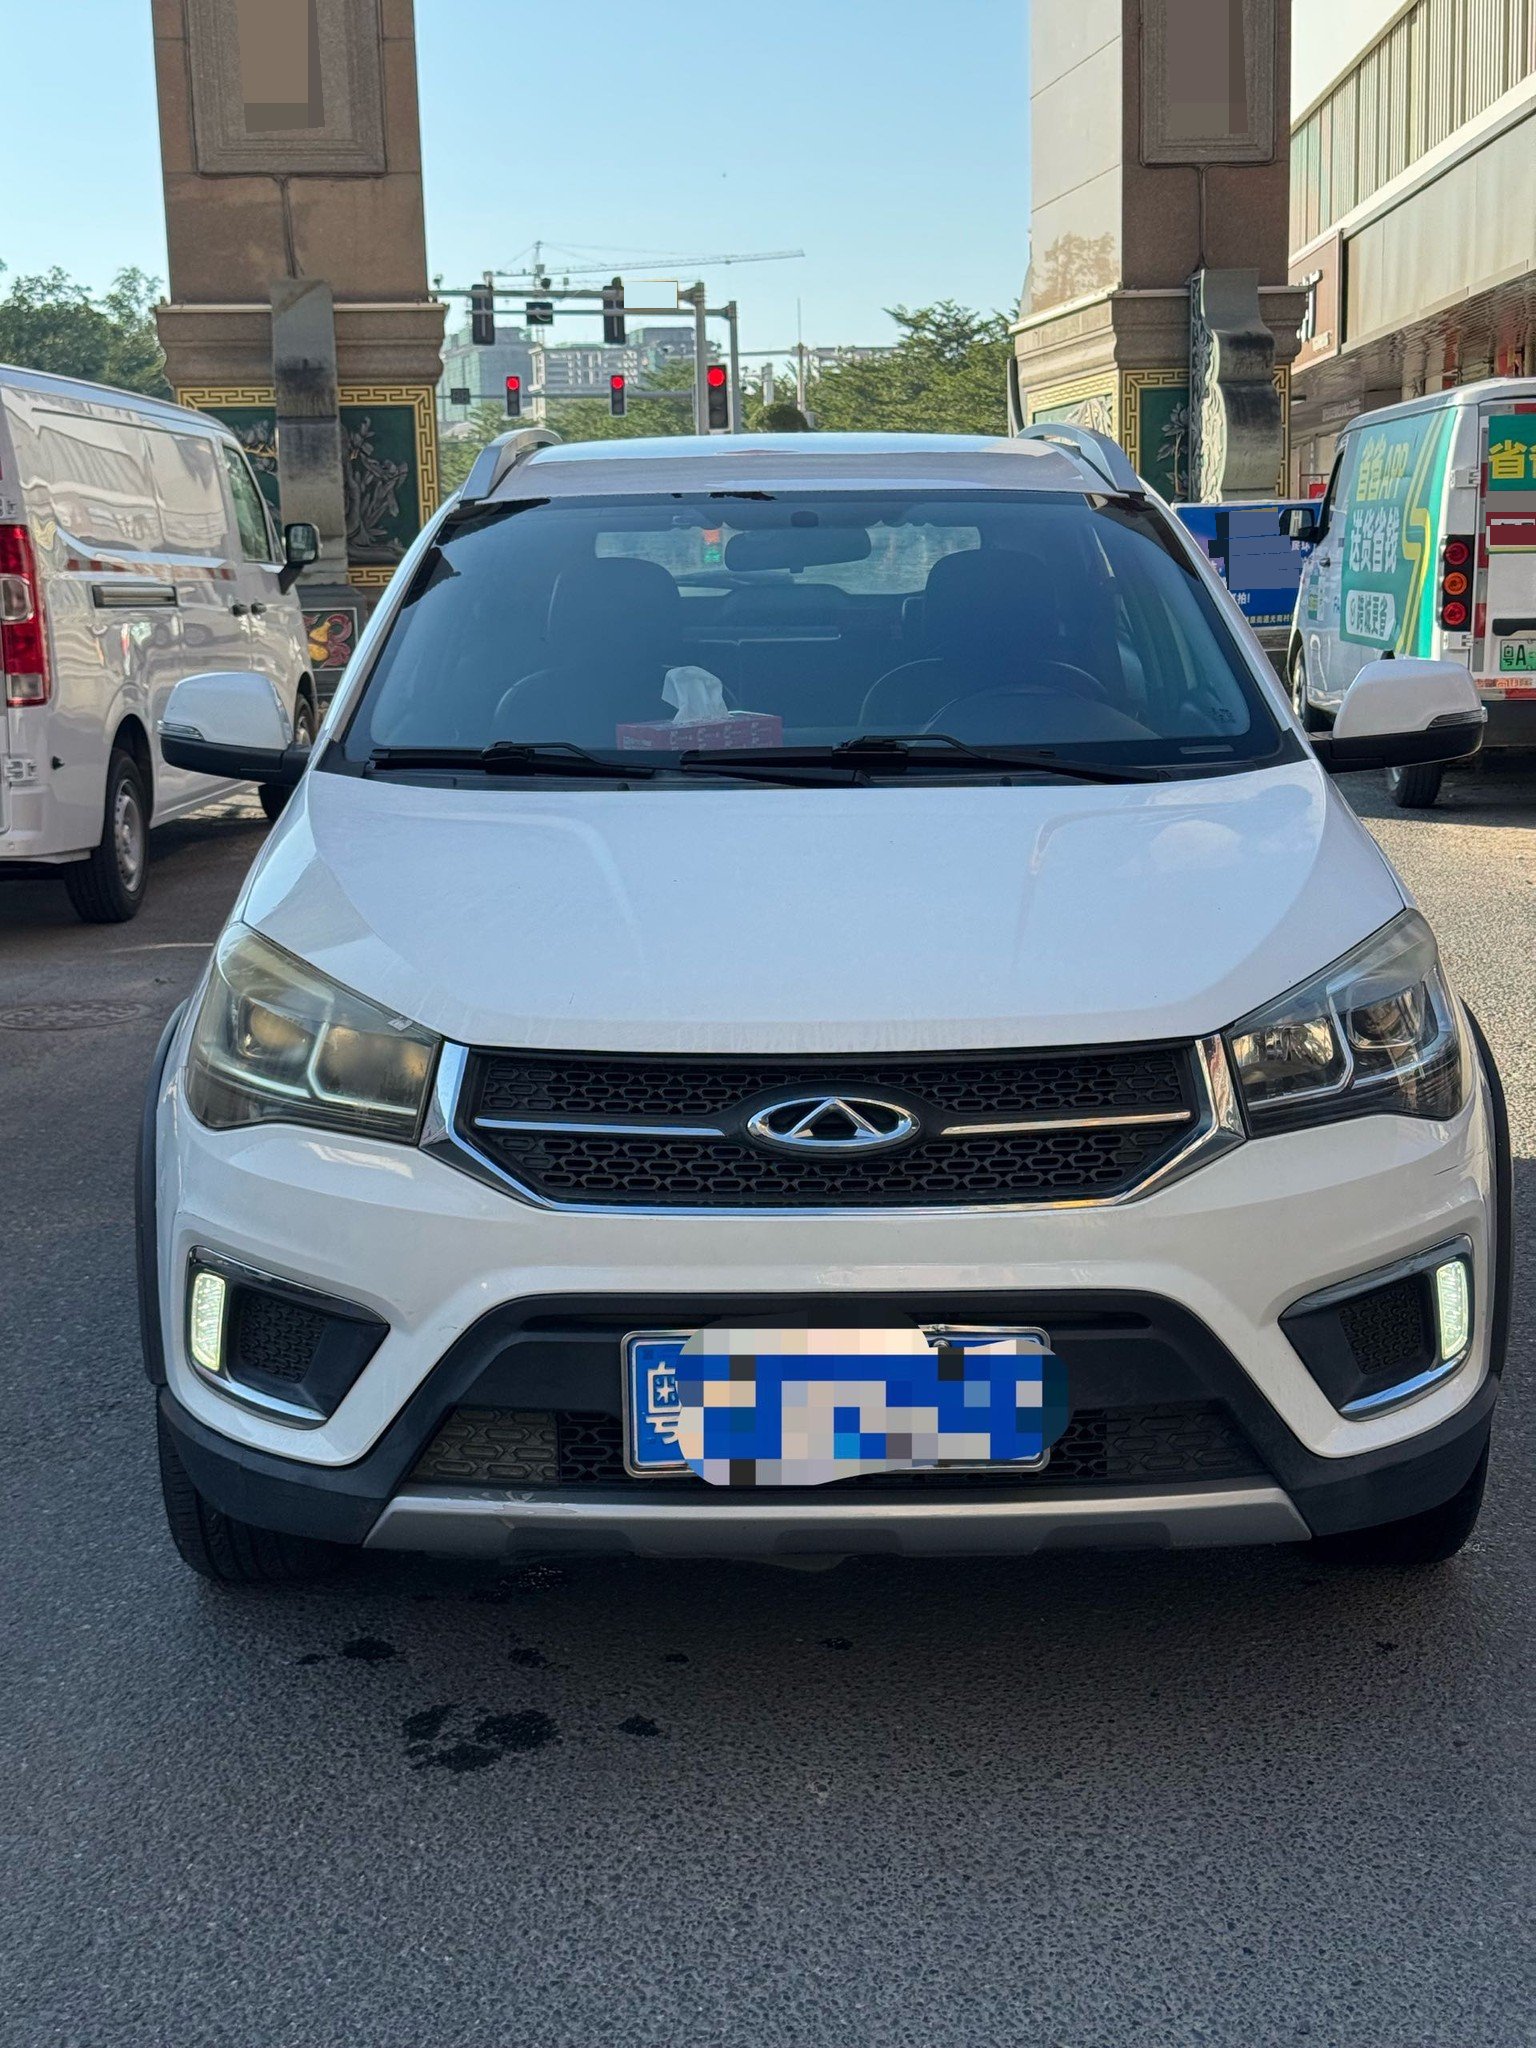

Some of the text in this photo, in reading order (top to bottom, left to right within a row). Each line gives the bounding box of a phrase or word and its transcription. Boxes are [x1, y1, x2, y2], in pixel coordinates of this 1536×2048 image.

[1357, 433, 1409, 501] 省省APP
[1488, 440, 1536, 479] 省
[1349, 507, 1400, 574] 送货省钱
